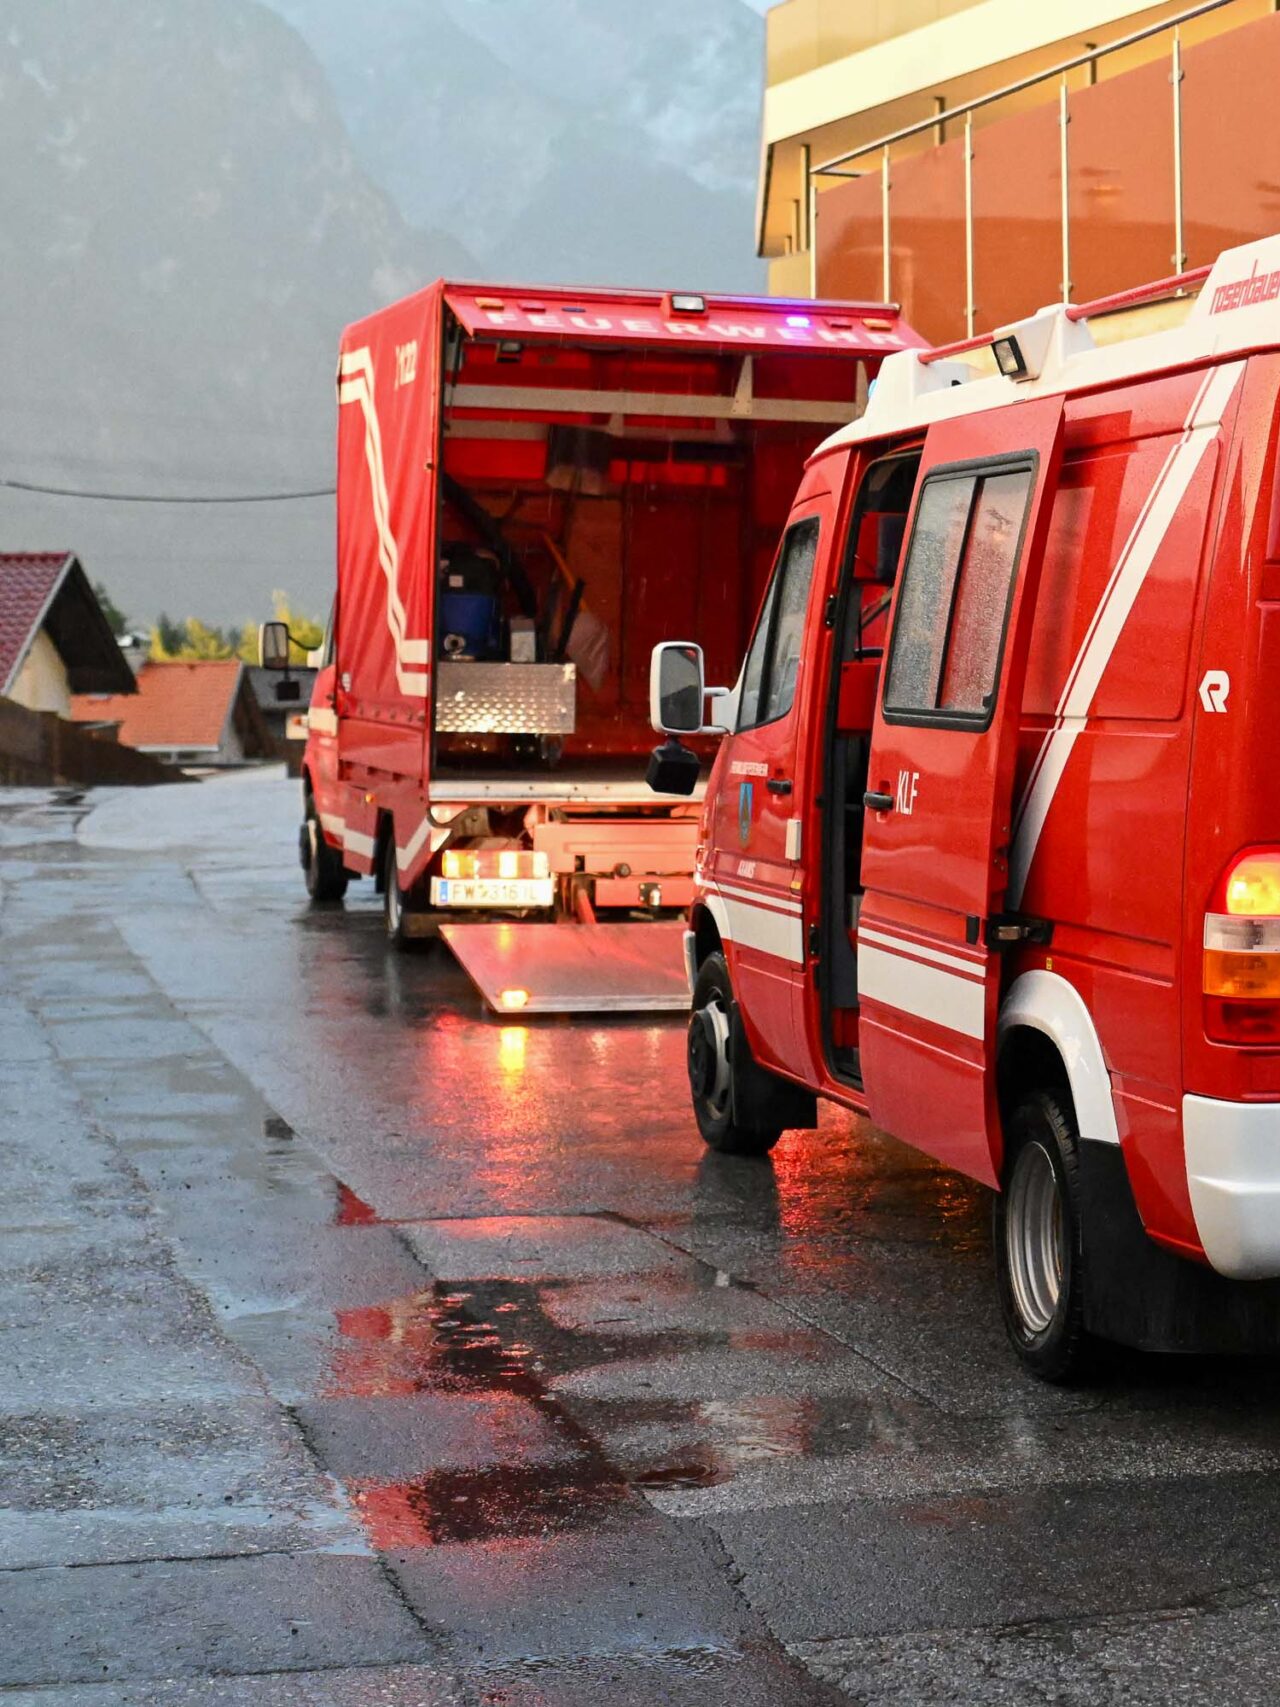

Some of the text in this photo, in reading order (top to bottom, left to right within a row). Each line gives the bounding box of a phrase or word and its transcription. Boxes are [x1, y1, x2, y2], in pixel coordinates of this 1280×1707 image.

[486, 312, 909, 346] FEUERWEHR
[896, 769, 919, 815] KLF
[453, 884, 475, 900] FW
